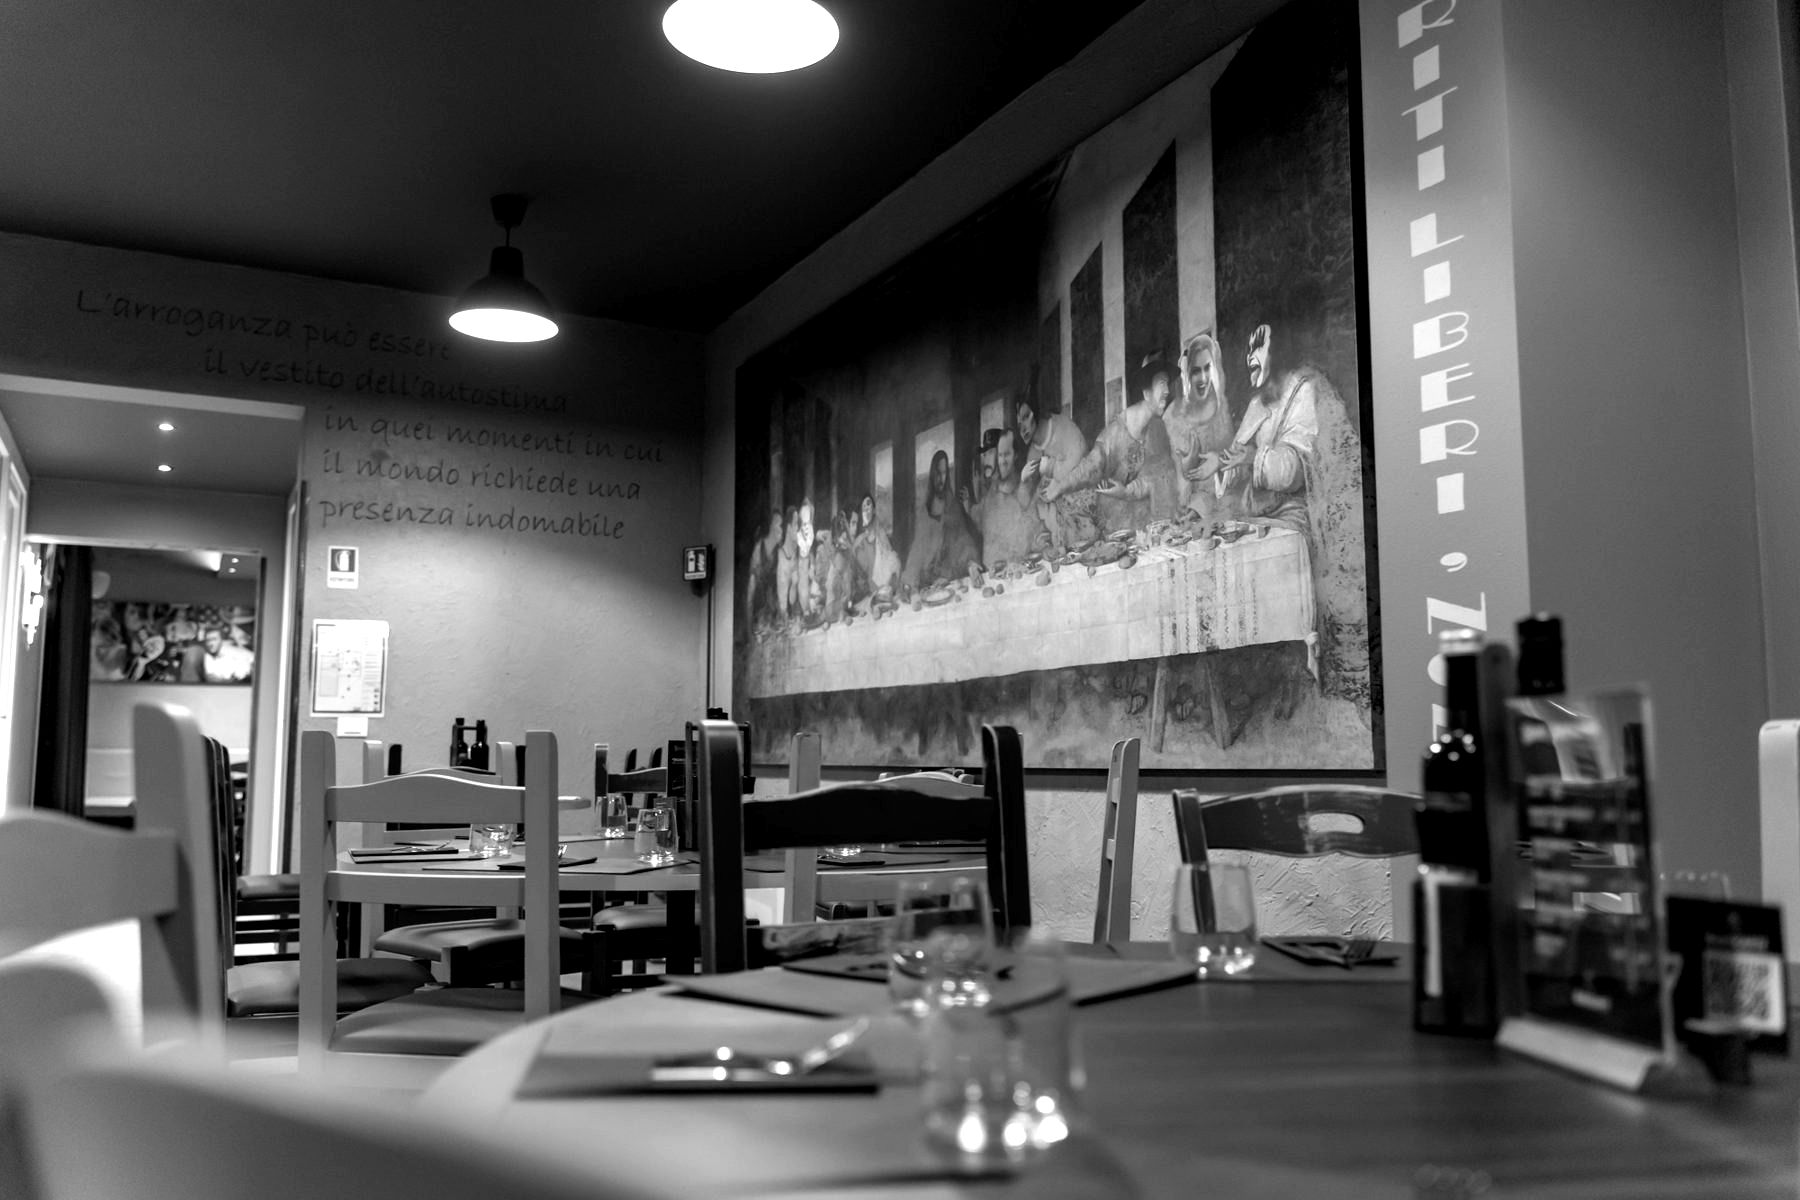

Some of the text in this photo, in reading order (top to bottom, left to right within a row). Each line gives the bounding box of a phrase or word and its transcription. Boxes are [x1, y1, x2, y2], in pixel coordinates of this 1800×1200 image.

[77, 289, 292, 339] L'arroganza
[303, 322, 358, 352] può
[206, 348, 567, 412] il vestito dell'autostima
[325, 405, 664, 463] in quei momenti in cui
[323, 449, 641, 500] il mondo richiede una
[319, 500, 625, 540] presenza indomabile
